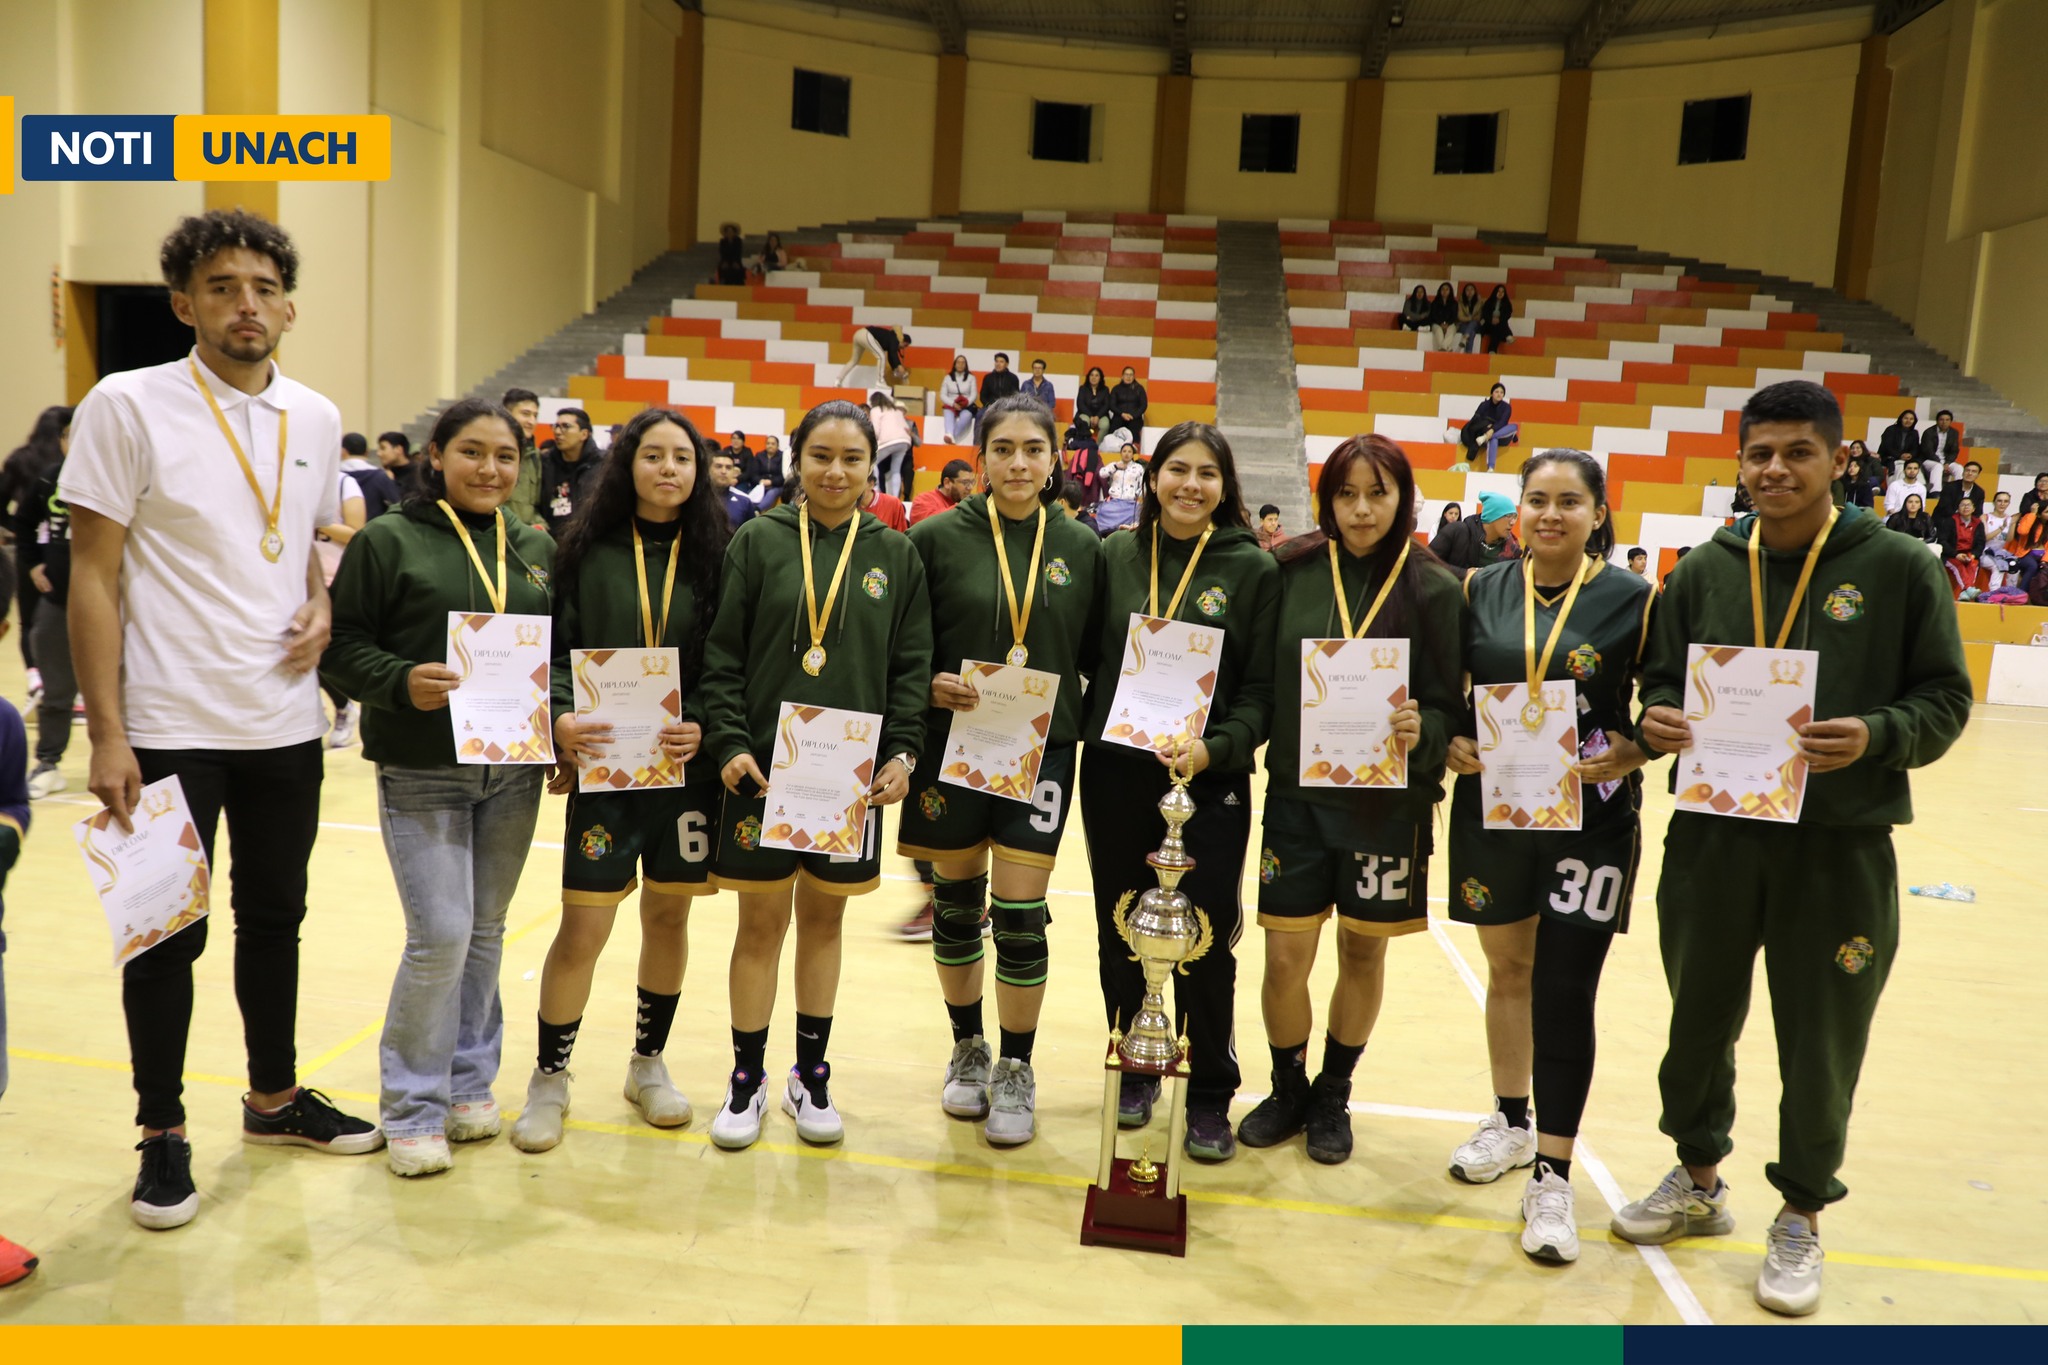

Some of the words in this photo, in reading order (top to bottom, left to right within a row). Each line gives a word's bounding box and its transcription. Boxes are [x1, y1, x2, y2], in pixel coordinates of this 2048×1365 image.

[1149, 649, 1182, 661] DIPLOMA
[1717, 686, 1765, 698] DIPLOMA
[801, 739, 838, 751] DIPLOMA
[1029, 780, 1062, 833] 9
[677, 811, 709, 863] 6
[1355, 852, 1409, 900] 32
[1549, 857, 1623, 922] 30
